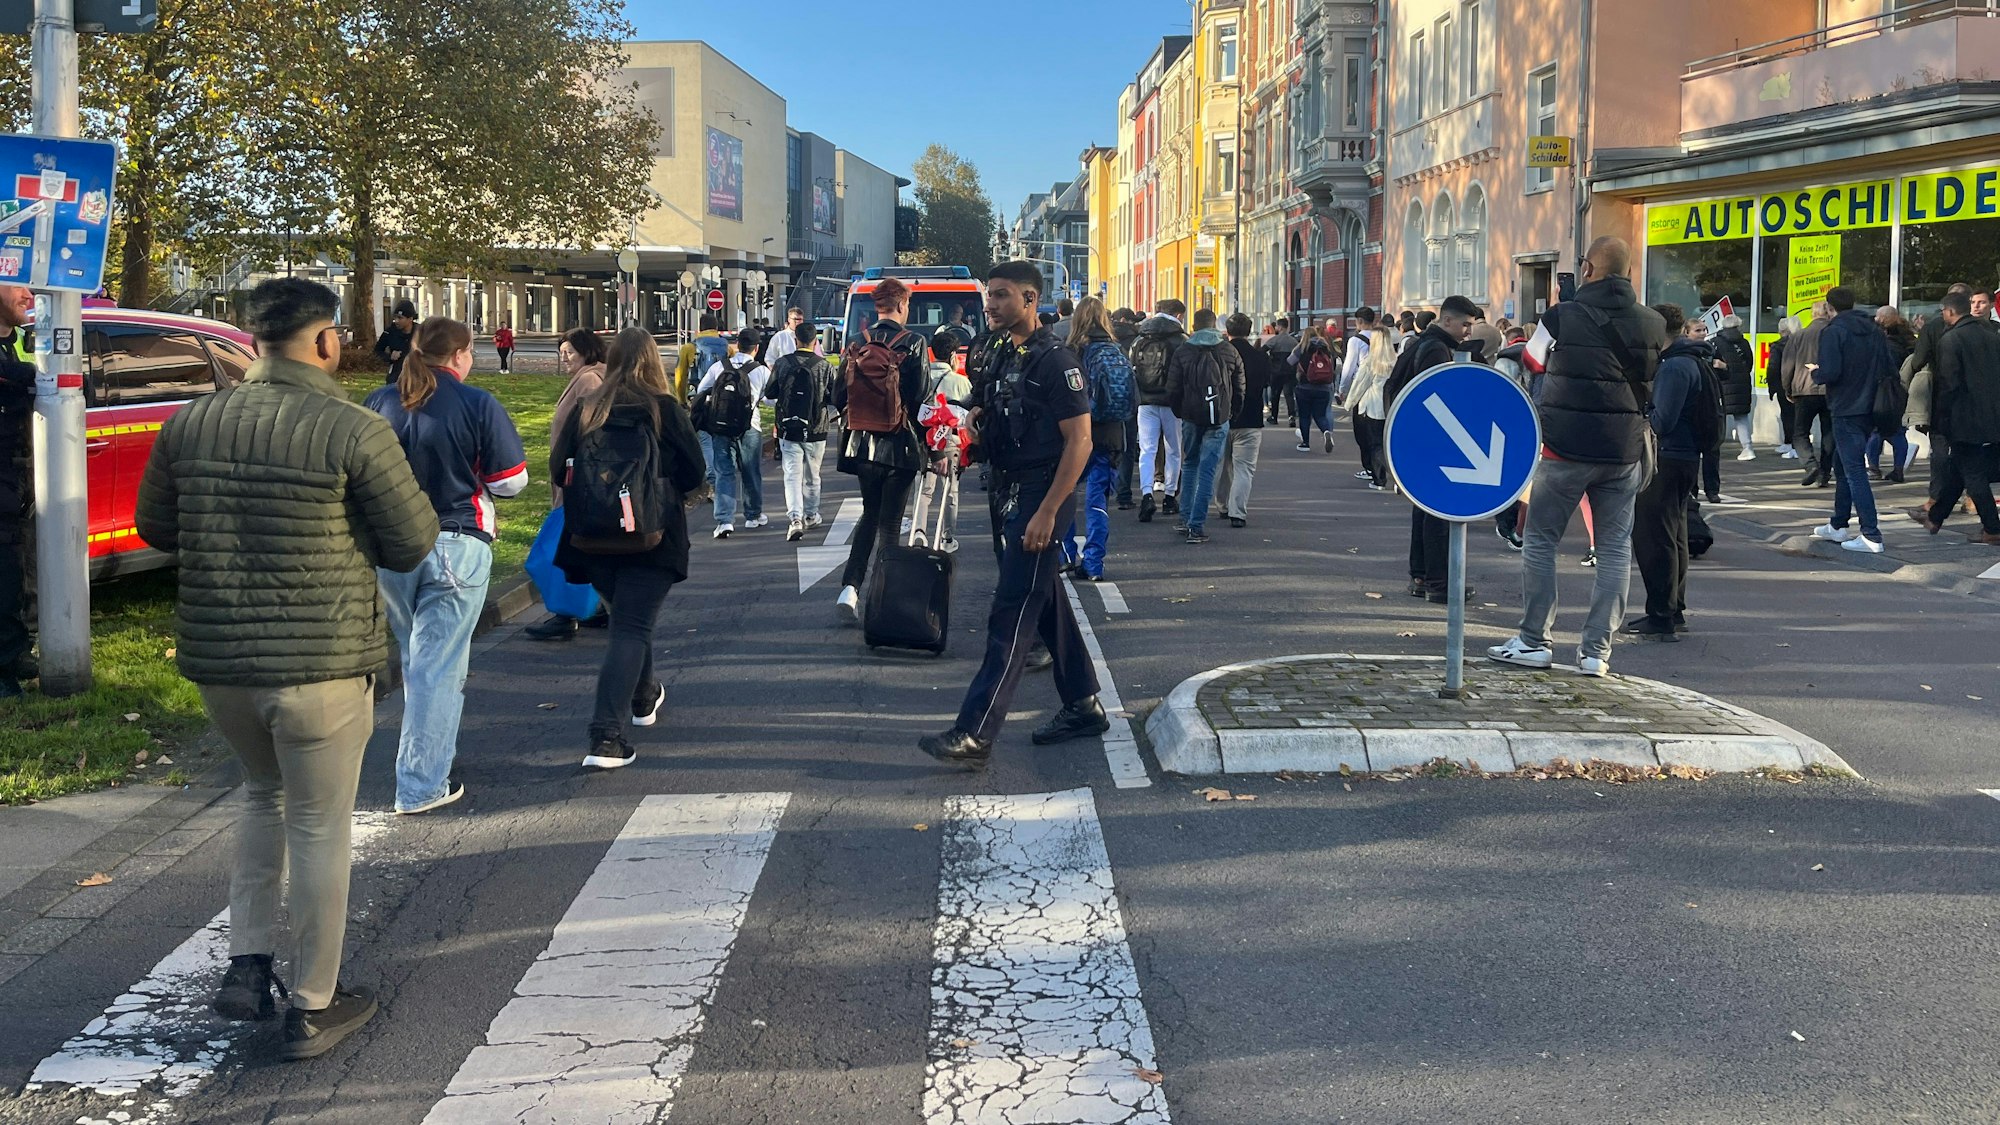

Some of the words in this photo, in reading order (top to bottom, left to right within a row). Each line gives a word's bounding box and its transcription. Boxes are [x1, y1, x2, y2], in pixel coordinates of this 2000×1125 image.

[1536, 140, 1562, 150] Auto-
[1531, 152, 1567, 162] Schilder
[1800, 245, 1814, 253] Keine
[1815, 244, 1829, 252] Zeit?
[1794, 256, 1807, 264] Kein
[1809, 254, 1834, 264] Termin?
